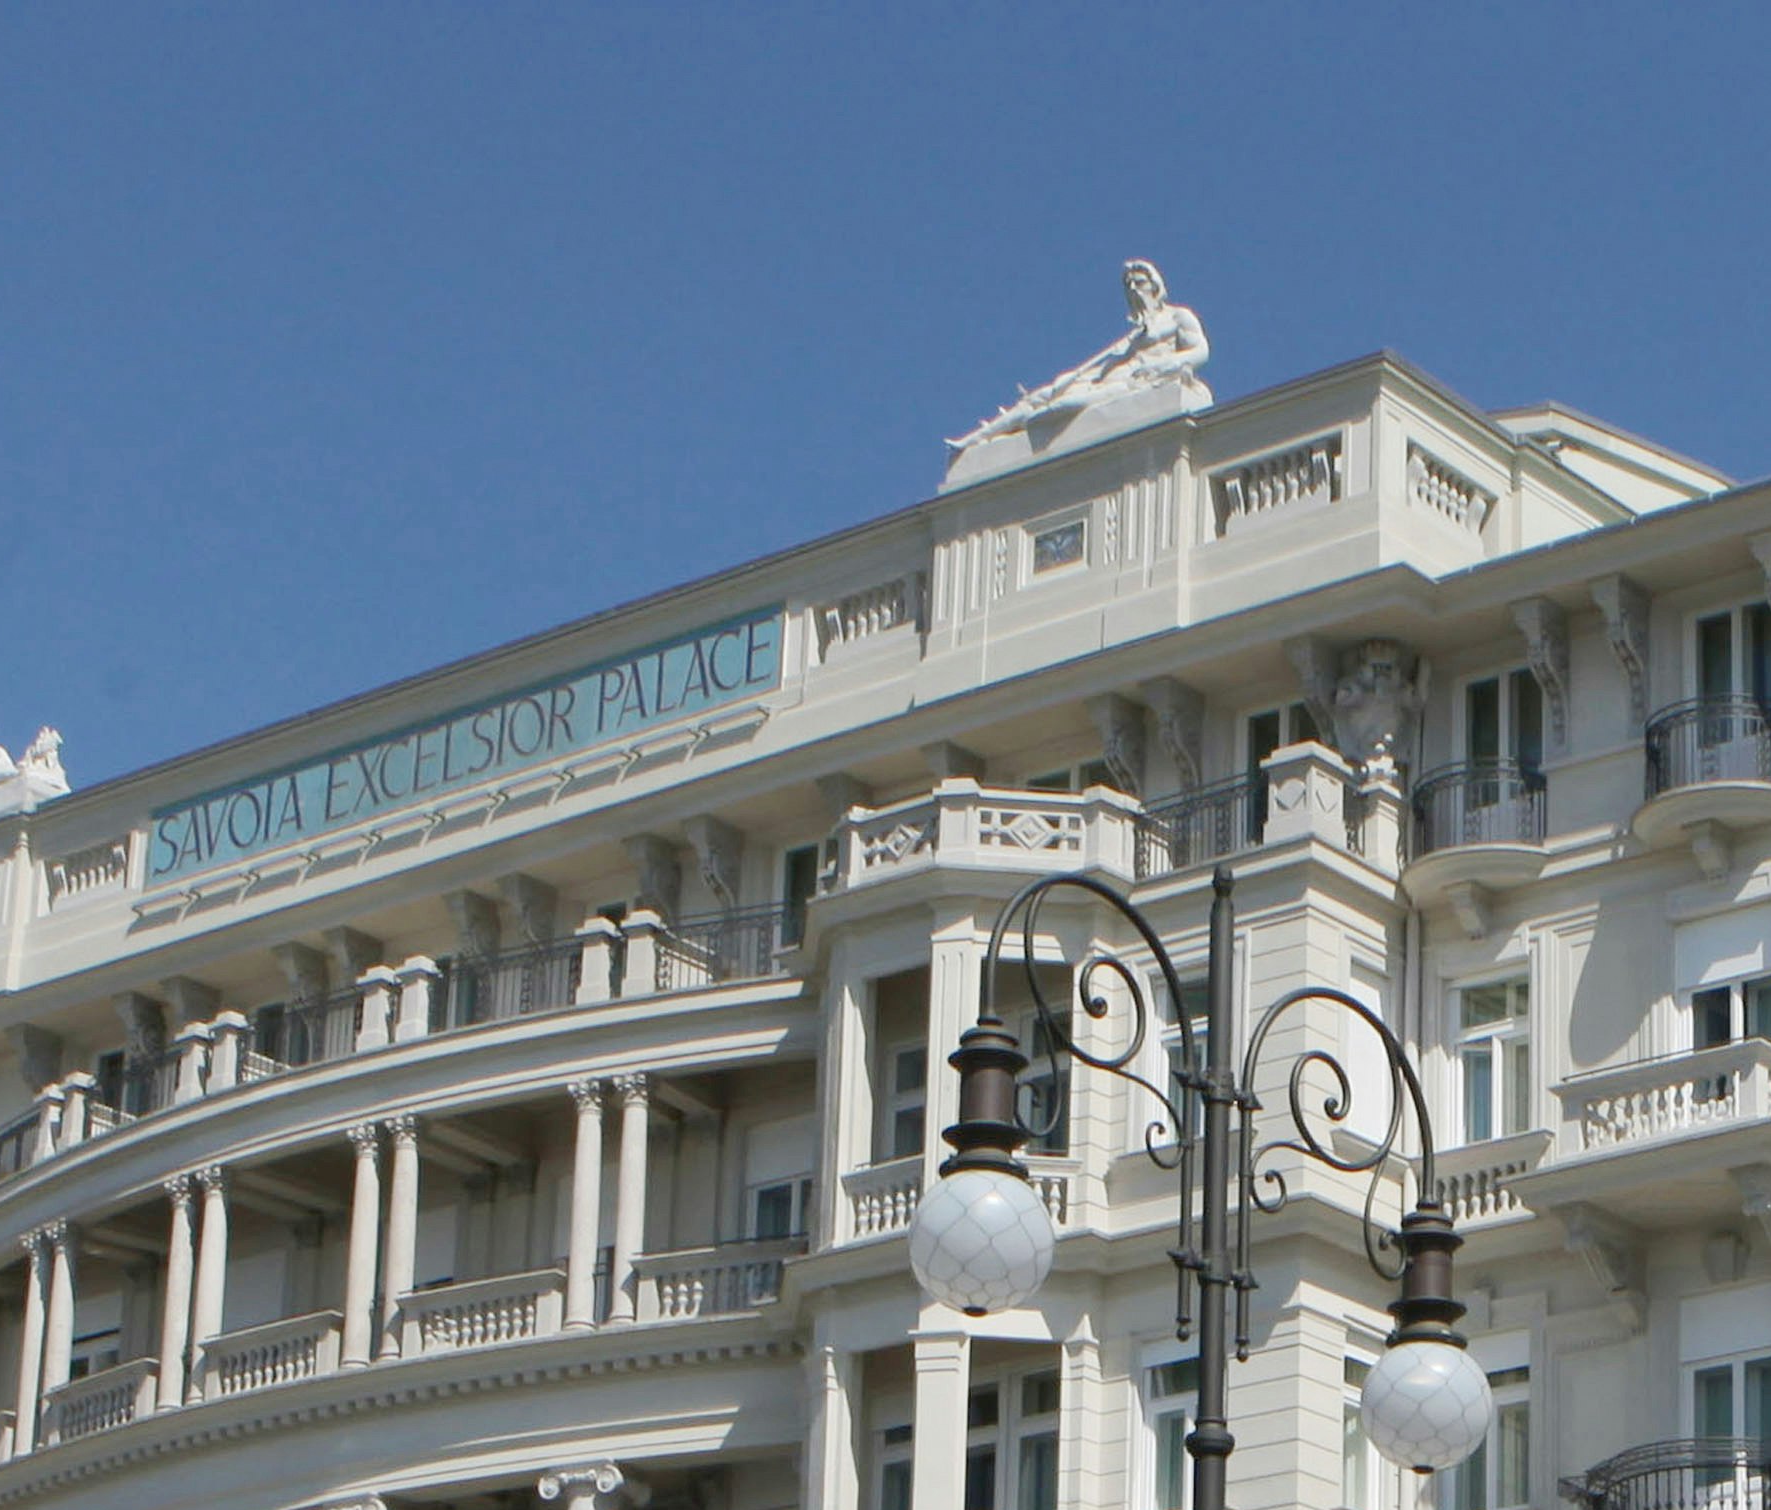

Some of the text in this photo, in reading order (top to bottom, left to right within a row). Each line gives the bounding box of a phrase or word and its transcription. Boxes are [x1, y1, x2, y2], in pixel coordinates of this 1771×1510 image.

[152, 616, 777, 877] SAVOIA EXCELSIOR PALACE
